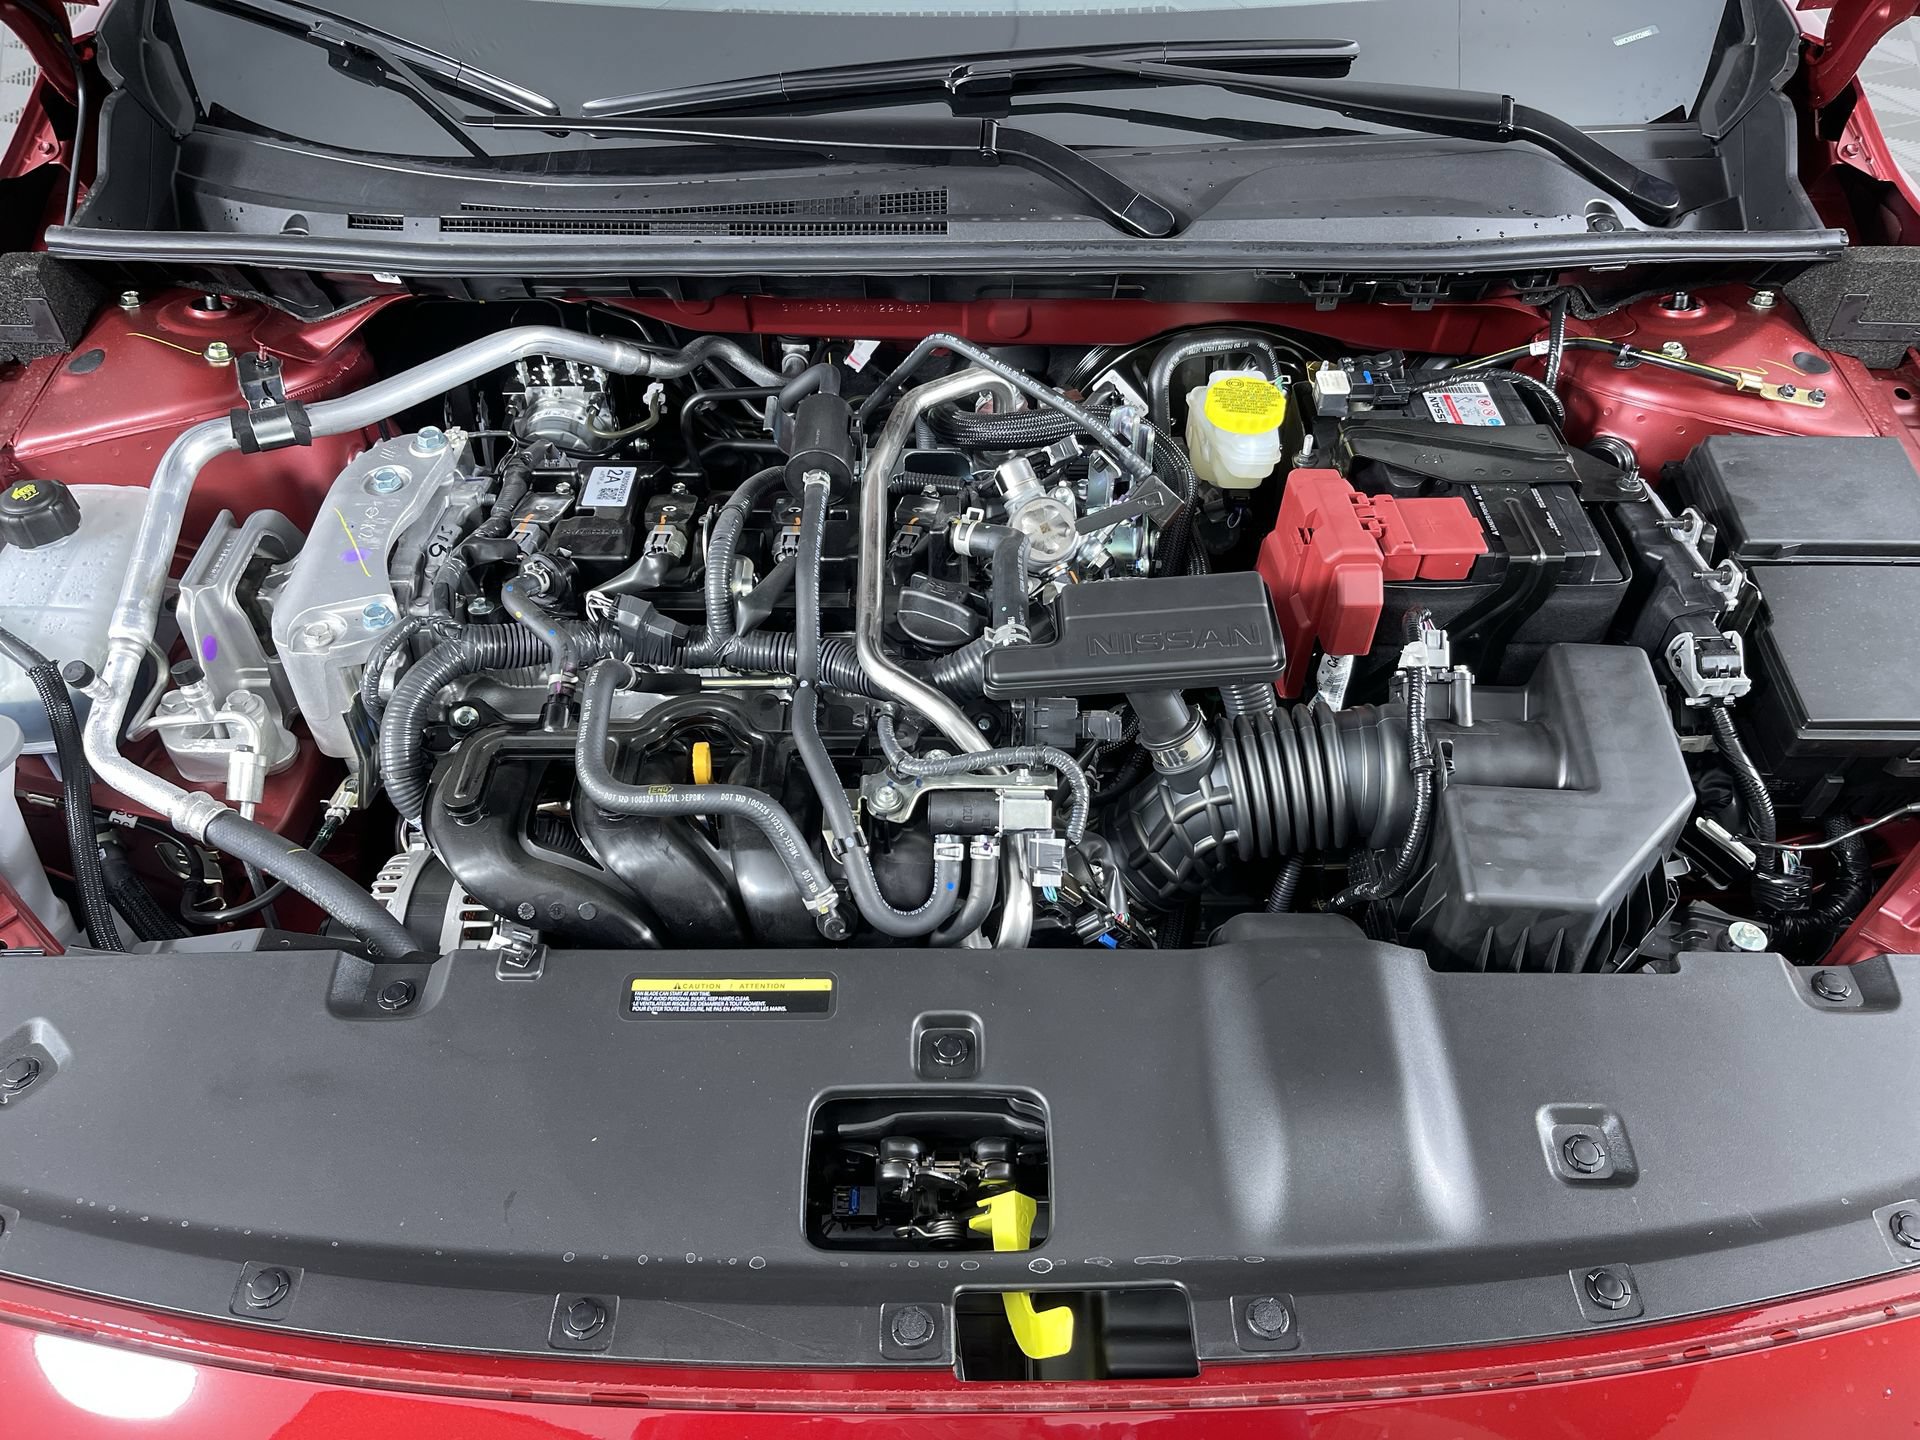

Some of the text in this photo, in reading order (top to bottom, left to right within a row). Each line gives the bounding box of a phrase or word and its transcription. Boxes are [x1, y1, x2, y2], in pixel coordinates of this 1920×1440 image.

[1428, 396, 1448, 422] ISSAN
[604, 469, 624, 484] 2A
[1086, 622, 1262, 657] NISSAN
[748, 798, 769, 816] 100326
[801, 869, 813, 882] DOT
